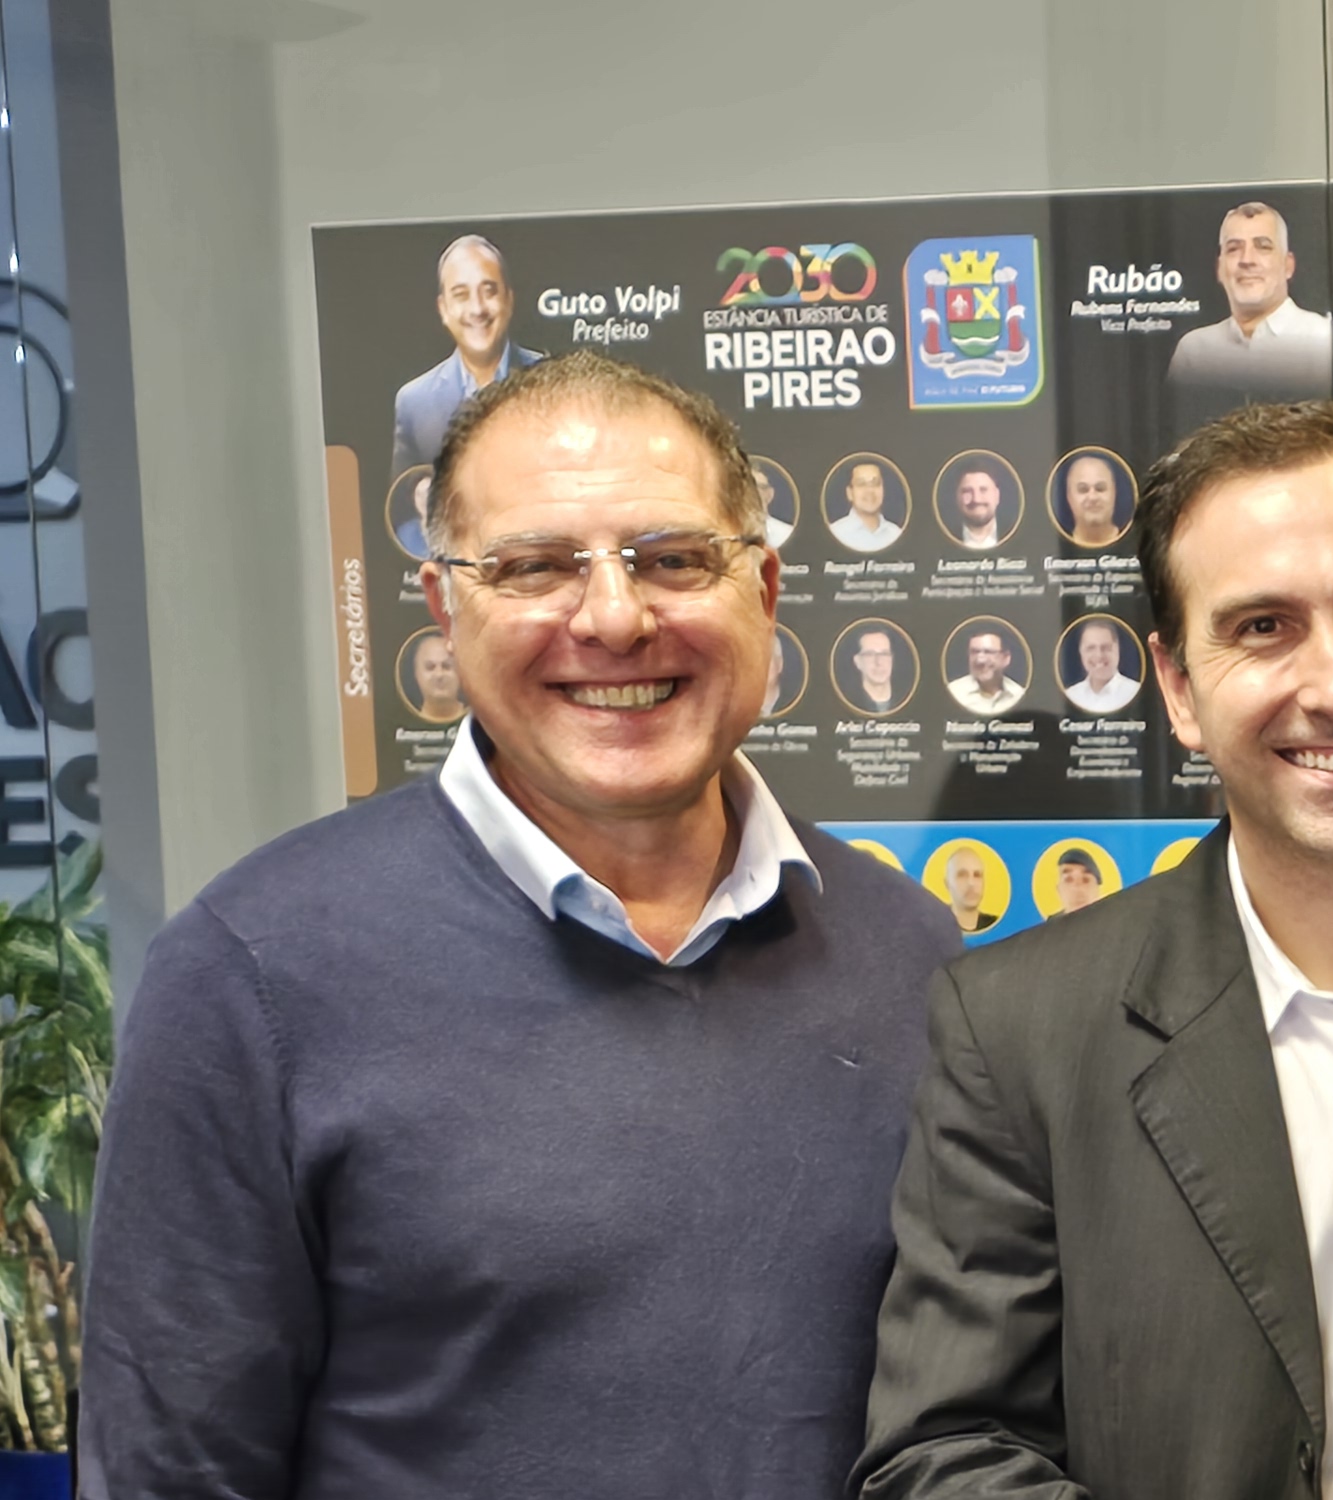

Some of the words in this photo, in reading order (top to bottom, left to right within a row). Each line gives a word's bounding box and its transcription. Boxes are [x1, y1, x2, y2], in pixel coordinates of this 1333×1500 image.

[716, 242, 878, 305] 2030
[1087, 263, 1183, 294] Rubão
[538, 289, 606, 316] Guto
[615, 285, 681, 319] Volpi
[703, 306, 781, 328] ESTÂNCIA
[865, 304, 889, 322] DE
[572, 319, 649, 344] Prefeito
[704, 327, 896, 370] RIBEIRAO
[744, 370, 861, 409] PIRES
[339, 558, 369, 697] Secretários
